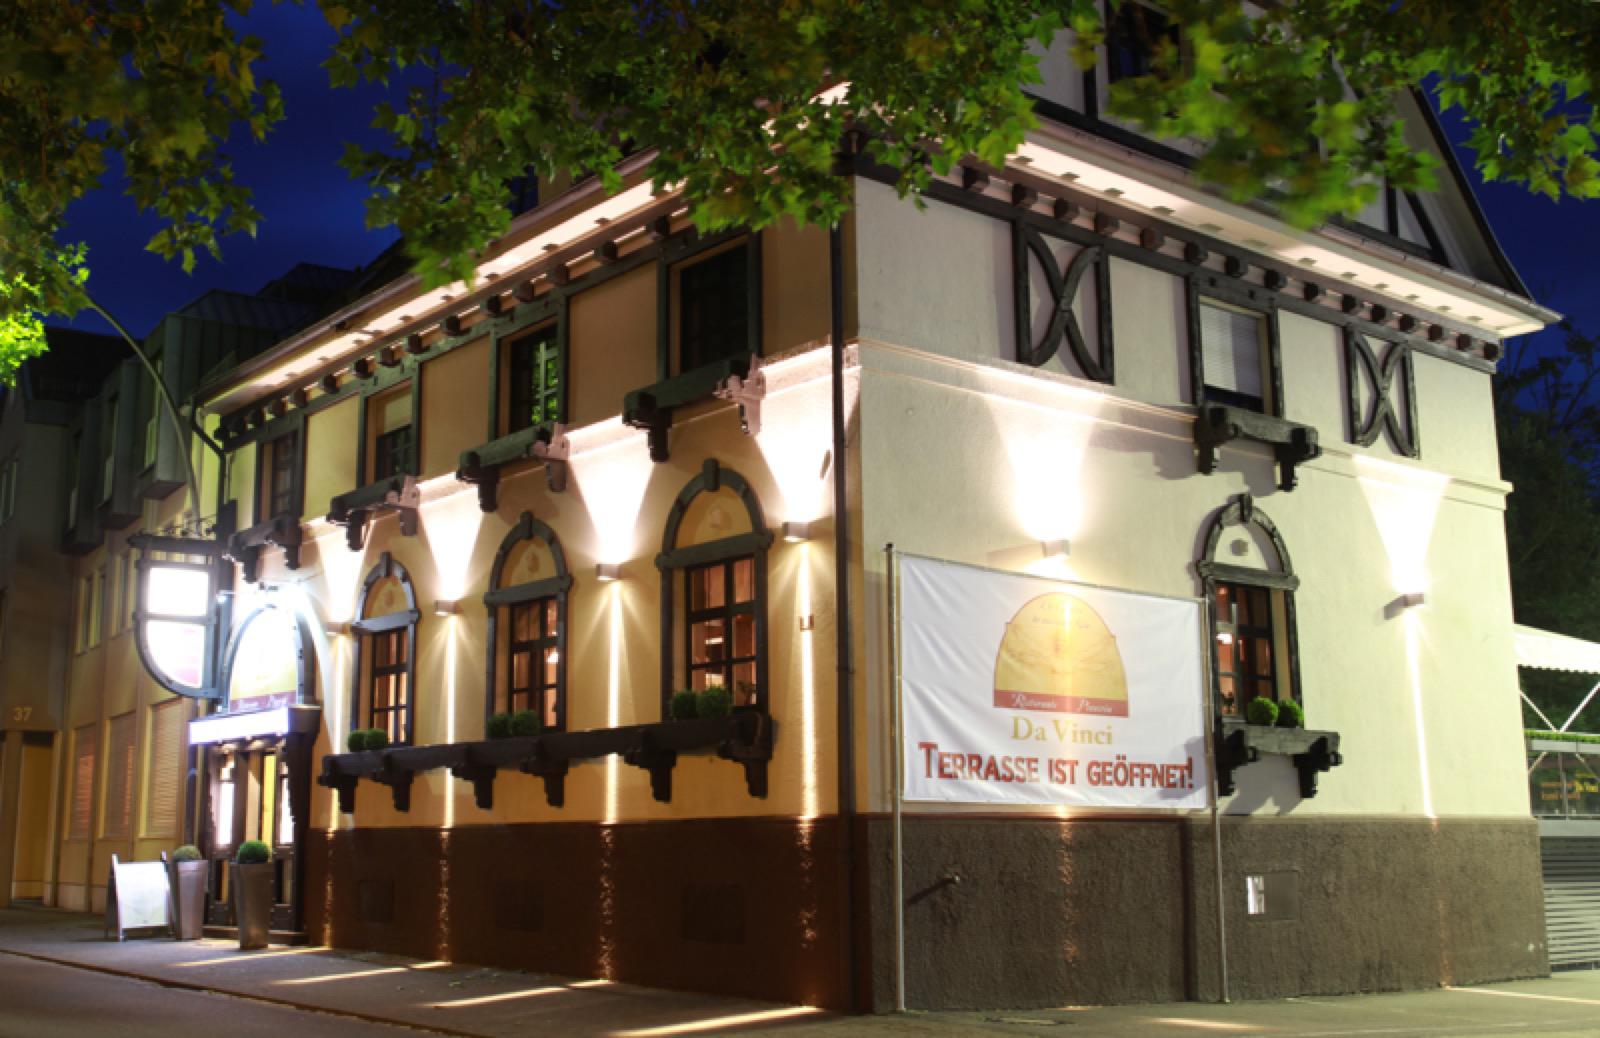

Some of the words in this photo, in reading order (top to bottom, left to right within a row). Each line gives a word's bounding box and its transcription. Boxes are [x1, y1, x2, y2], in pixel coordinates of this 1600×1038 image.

[14, 706, 33, 722] 37
[1010, 715, 1047, 742] Da
[1052, 719, 1114, 745] Vinci
[918, 741, 1040, 783] TERRASSE
[1048, 756, 1079, 785] IST
[1087, 754, 1194, 789] GEÖFFNET!
